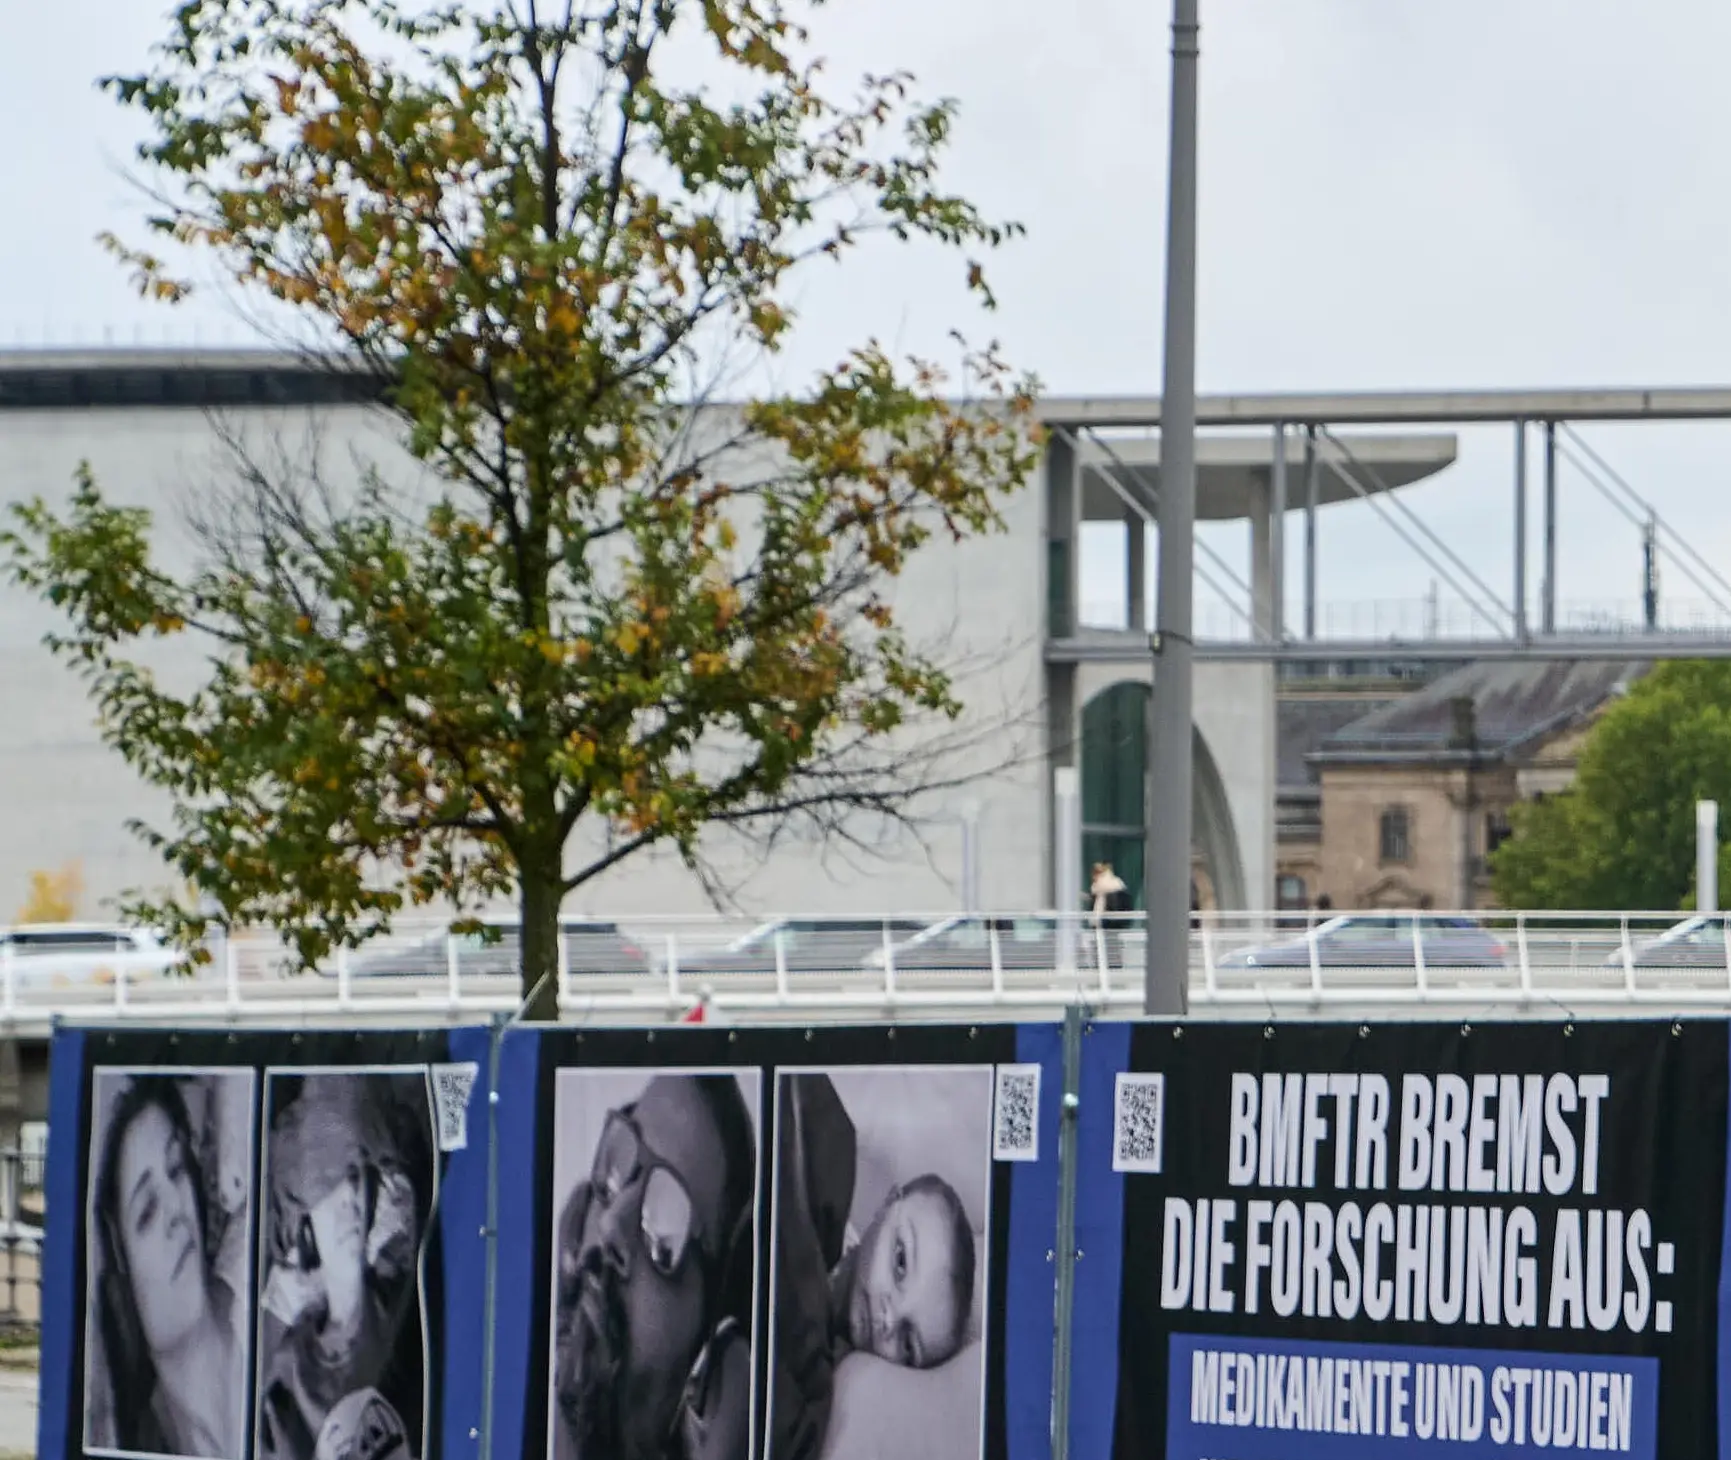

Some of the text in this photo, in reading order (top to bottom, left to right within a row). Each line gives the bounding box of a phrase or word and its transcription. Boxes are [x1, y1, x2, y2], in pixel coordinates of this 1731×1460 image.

[1229, 1072, 1609, 1195] BMFTR BREMST
[1160, 1196, 1675, 1332] DIE FORSCHUNG AUS:
[1191, 1350, 1633, 1452] MEDIKAMENTE UND STUDIEN
